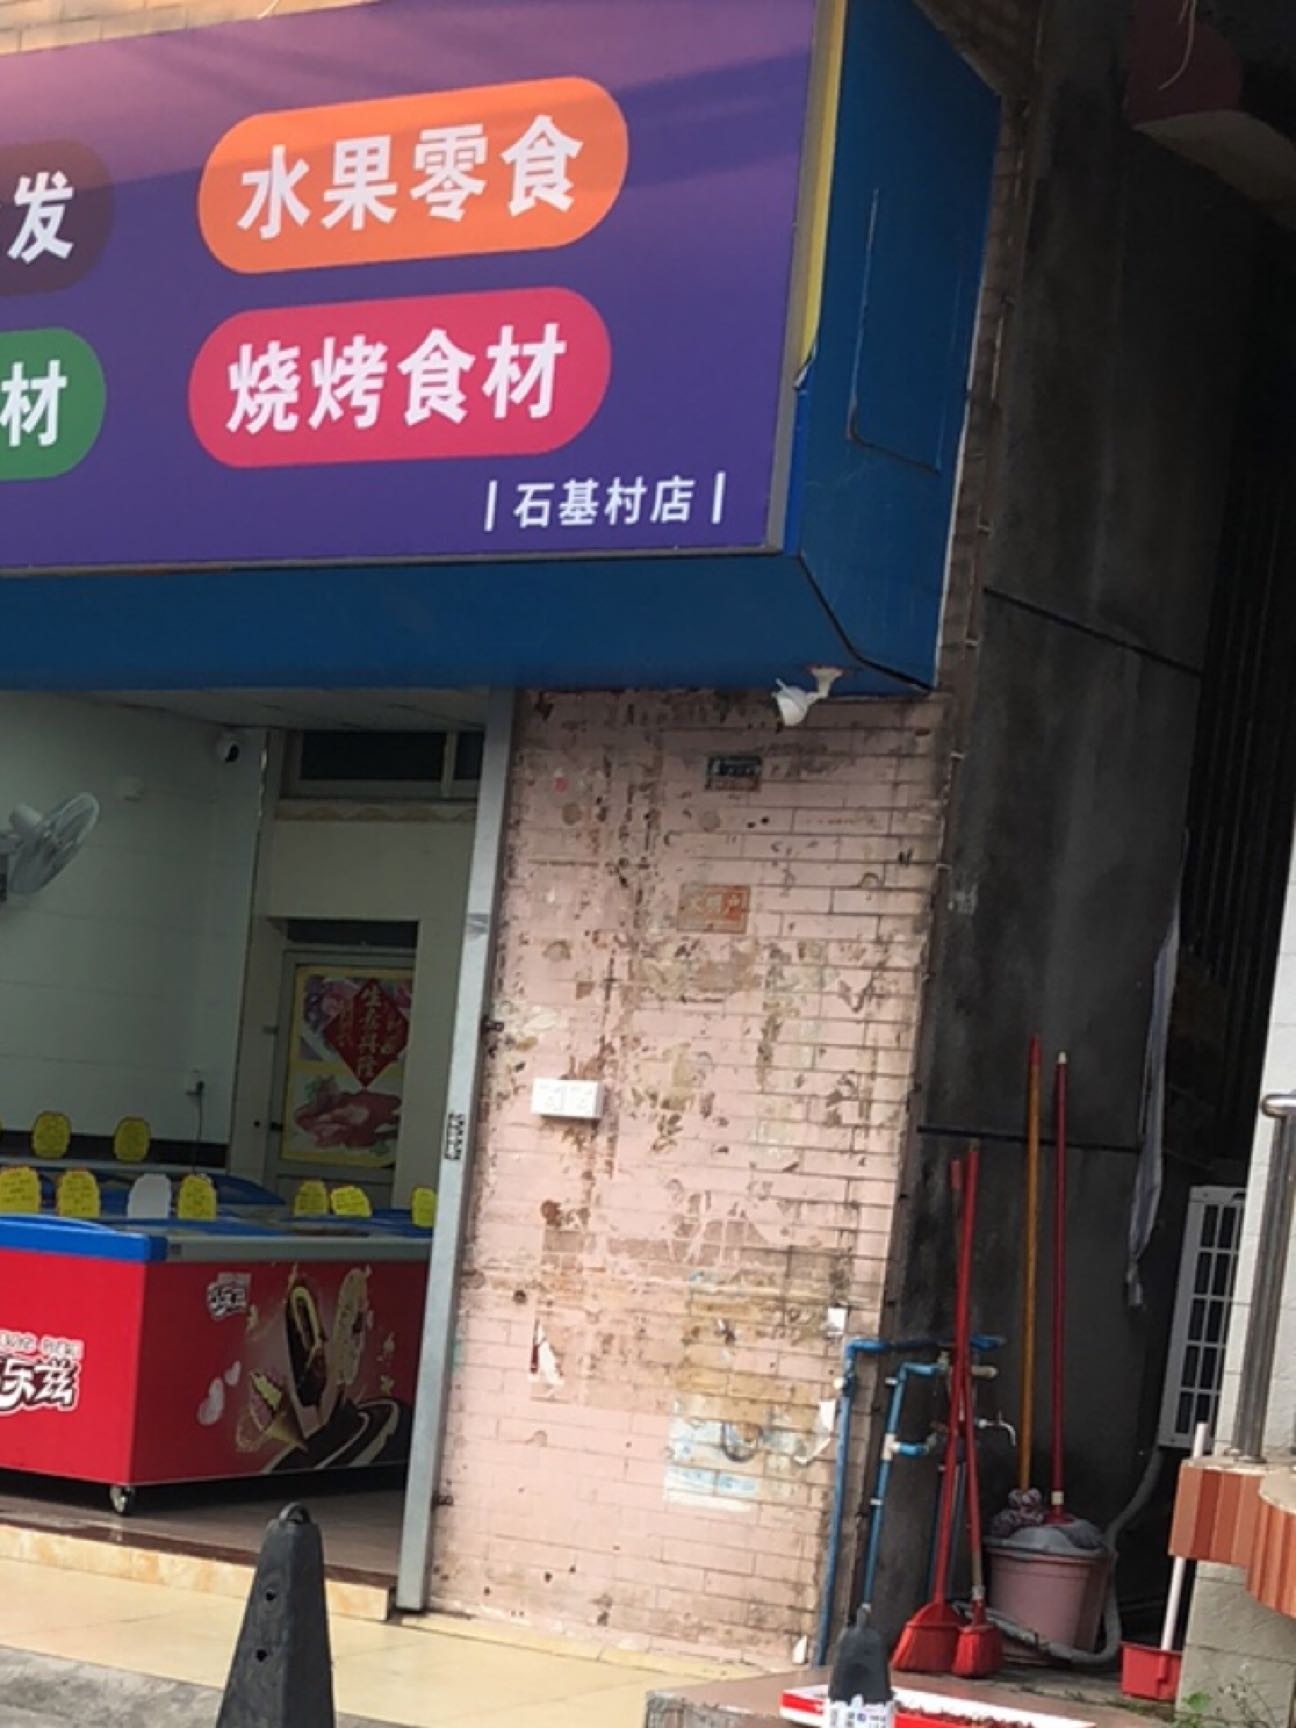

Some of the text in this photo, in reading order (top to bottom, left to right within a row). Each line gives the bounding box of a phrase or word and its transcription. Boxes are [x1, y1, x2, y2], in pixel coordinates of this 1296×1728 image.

[237, 115, 583, 239] 水果零食
[226, 323, 566, 433] 烧烤食材
[513, 476, 694, 528] 石基村店
